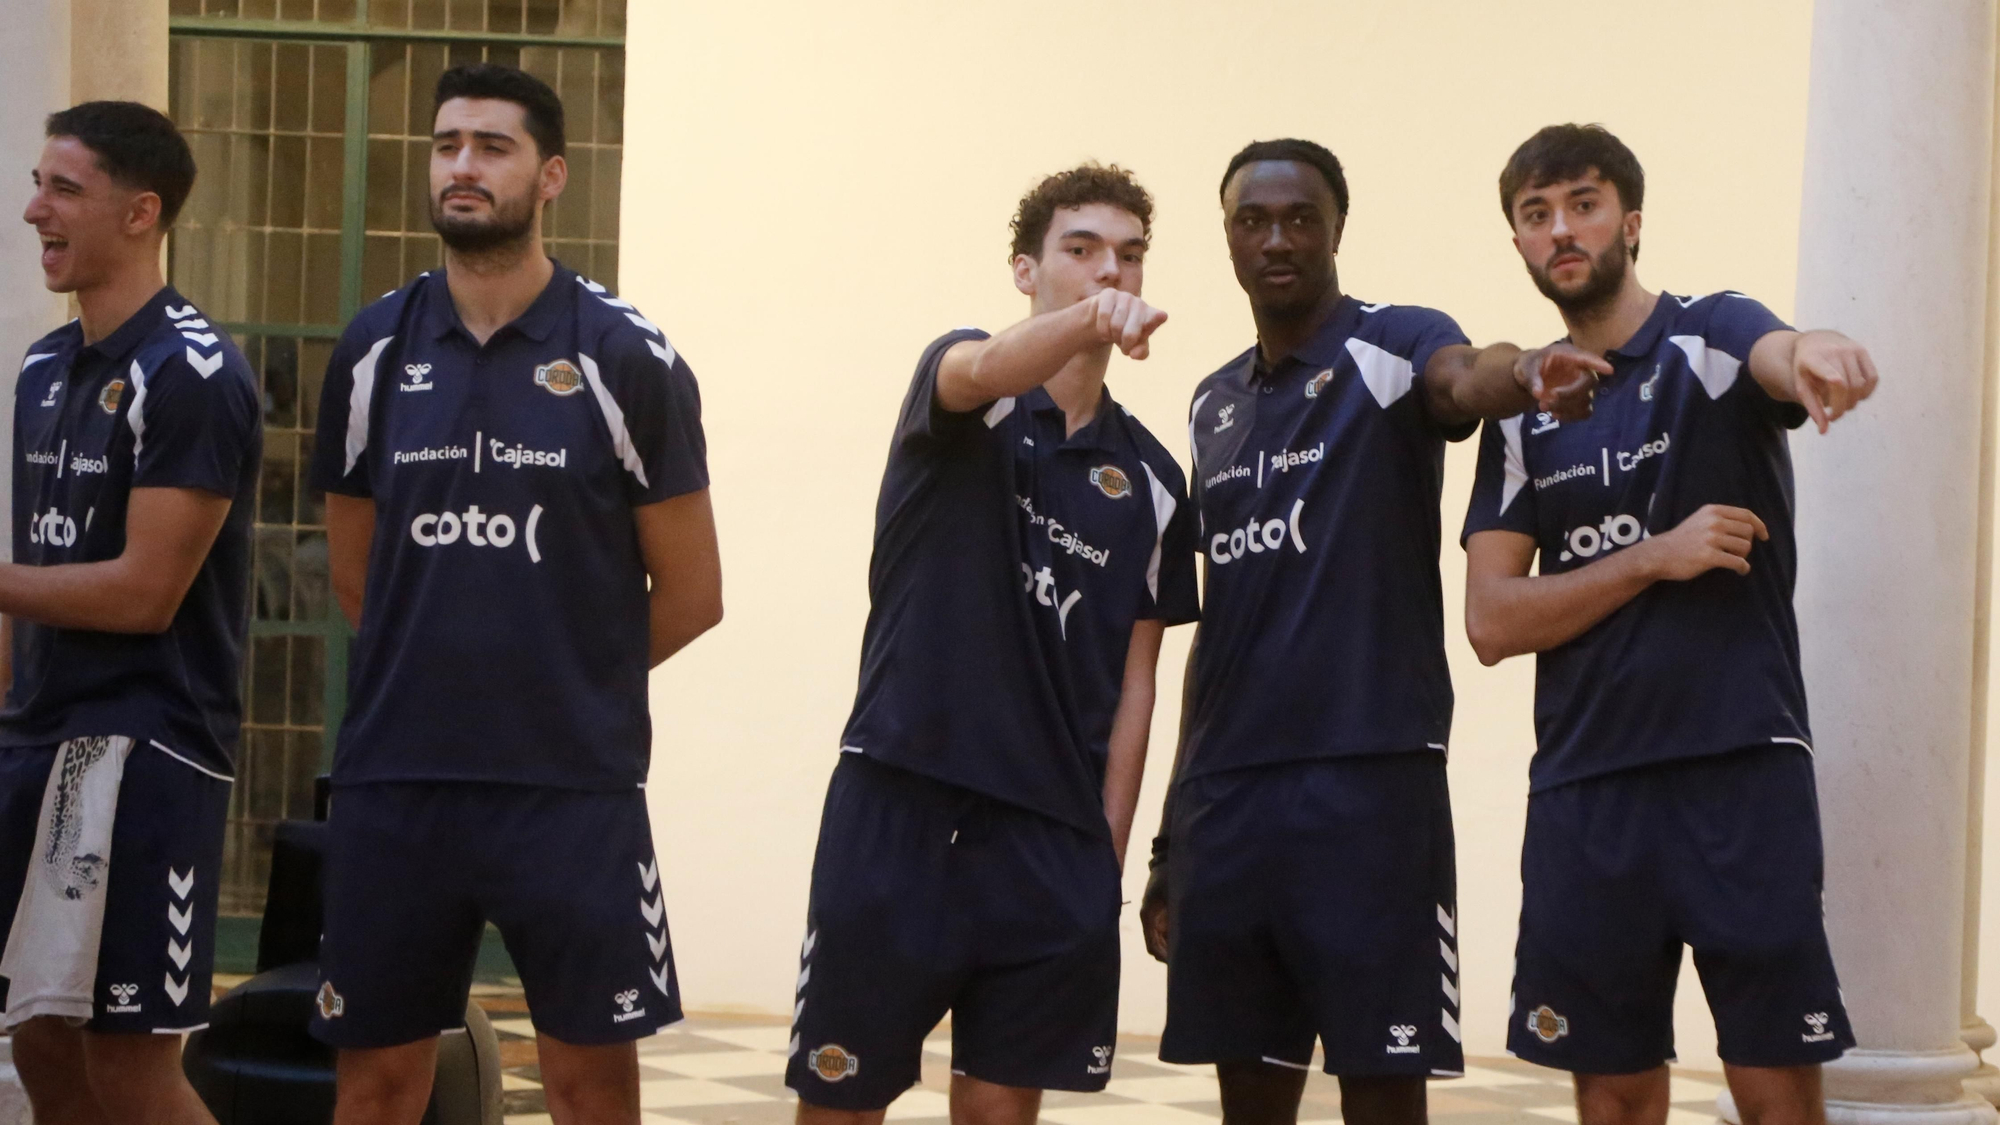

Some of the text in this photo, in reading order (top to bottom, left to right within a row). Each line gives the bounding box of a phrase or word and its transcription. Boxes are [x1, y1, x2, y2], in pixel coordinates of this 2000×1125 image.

[70, 451, 108, 476] ajasol
[394, 438, 566, 469] Fundación Cajasol
[1271, 441, 1324, 473] ajasol
[1534, 463, 1596, 491] Fundación
[1047, 518, 1110, 567] Cajasol
